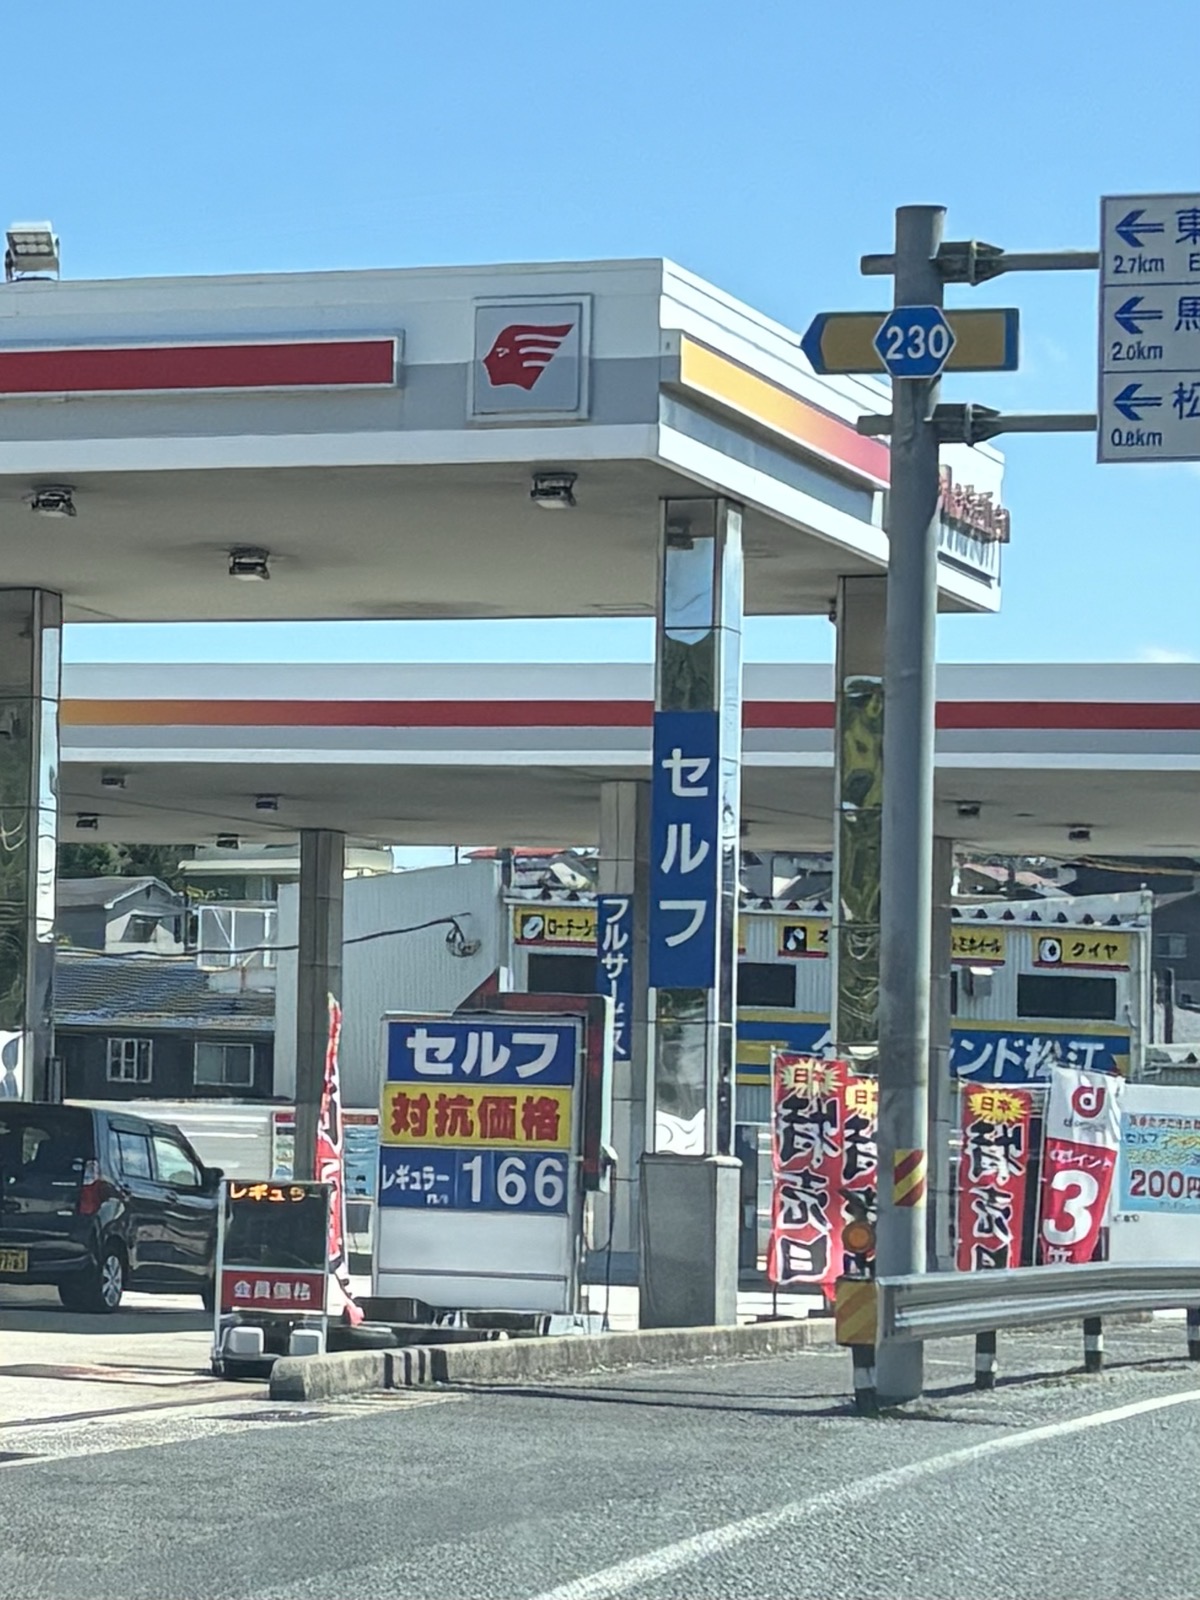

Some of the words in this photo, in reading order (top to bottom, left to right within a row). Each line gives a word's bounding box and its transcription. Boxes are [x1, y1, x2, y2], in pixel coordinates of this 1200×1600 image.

[1113, 253, 1164, 274] 2.7km
[885, 324, 949, 360] 230
[1112, 341, 1163, 361] 2.0km
[659, 748, 711, 948] セルフ
[406, 1028, 559, 1079] セルフ
[391, 1092, 560, 1142] 対抗価格
[382, 1165, 450, 1191] レギュラー
[462, 1155, 564, 1207] 166
[1042, 1169, 1099, 1246] 3
